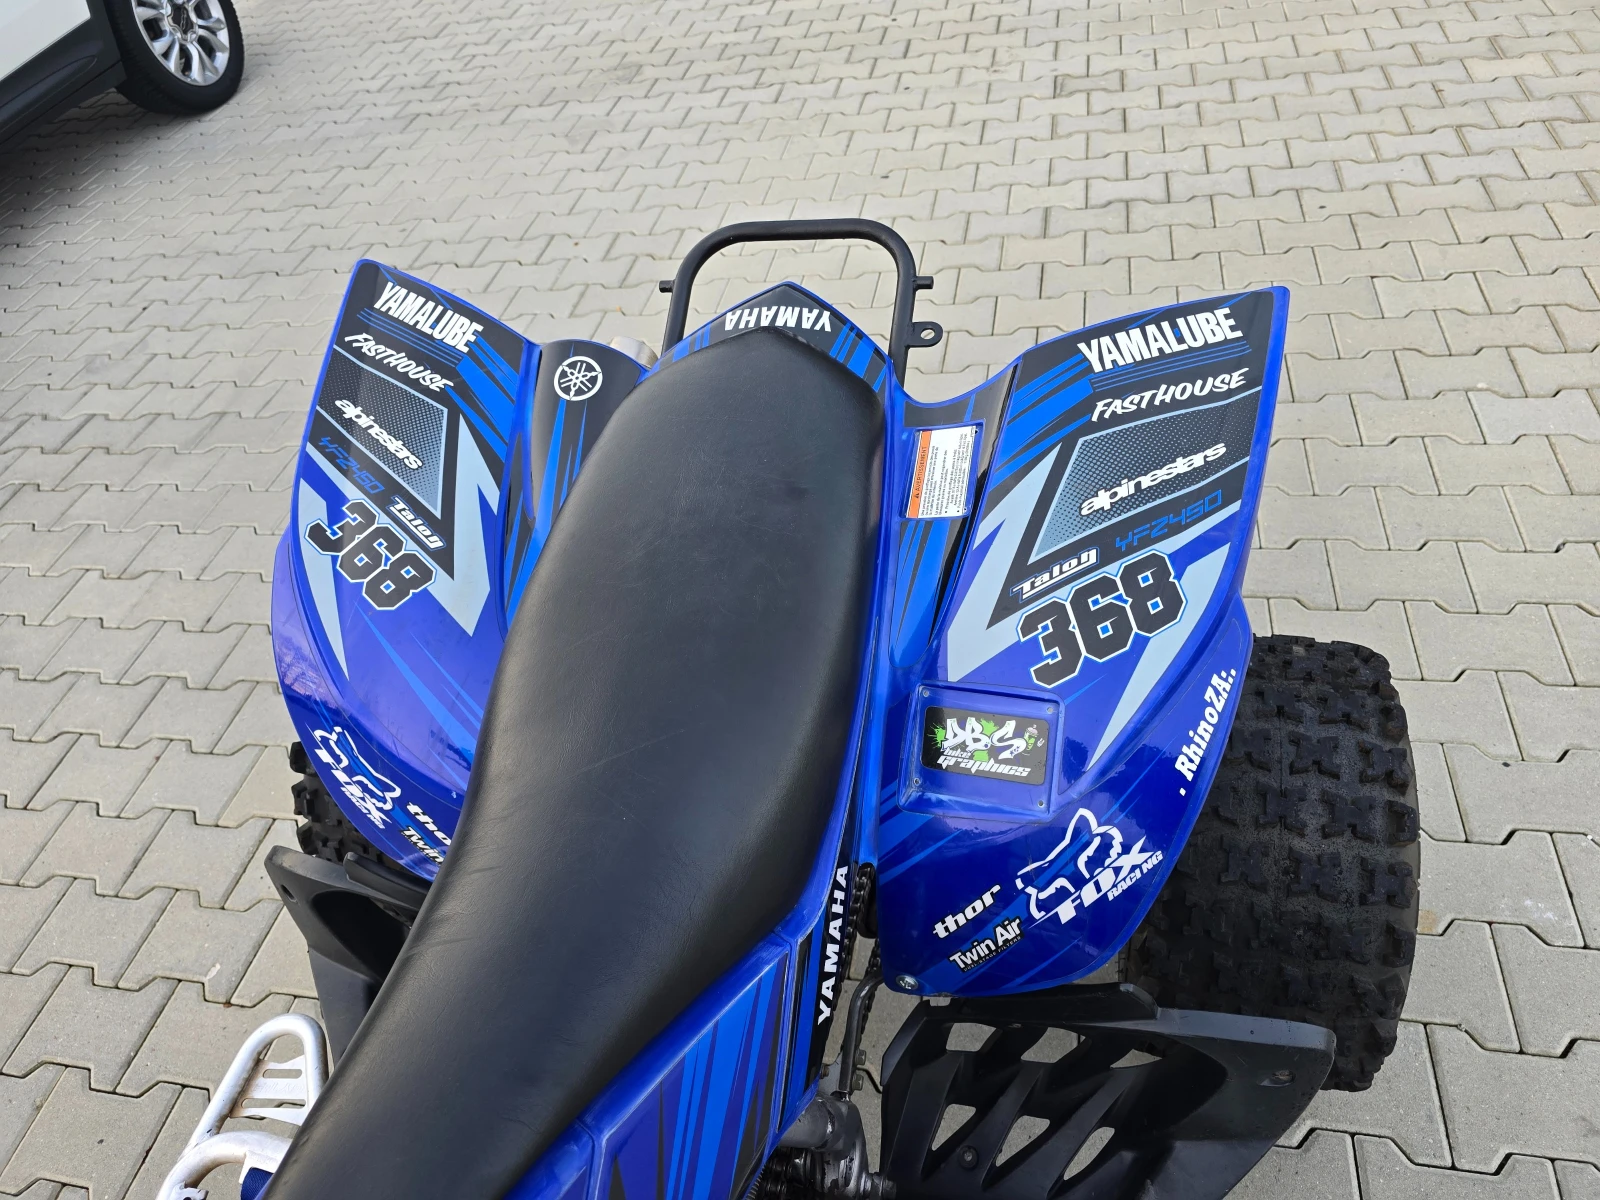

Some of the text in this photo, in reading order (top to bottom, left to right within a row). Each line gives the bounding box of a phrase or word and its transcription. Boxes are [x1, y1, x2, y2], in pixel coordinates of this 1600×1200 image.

[373, 282, 484, 353] YAMALUBE
[724, 306, 831, 332] YAMAHA
[1077, 307, 1243, 374] YAMALUBE
[345, 333, 454, 393] FASTHOUSE
[1091, 367, 1250, 422] FASTHOUSE
[335, 398, 422, 470] alpinestars
[1079, 442, 1227, 517] alpinestars
[304, 499, 437, 611] 368
[1011, 548, 1098, 602] Talon
[1016, 549, 1188, 688] 368
[936, 755, 1032, 778] graphics
[403, 826, 445, 863] Twin
[406, 801, 452, 846] tho
[1030, 835, 1155, 928] FOX
[1106, 850, 1164, 902] RACING
[932, 884, 1001, 940] thor
[817, 865, 849, 1026] YAMAHA
[949, 918, 1021, 969] Twin Air
